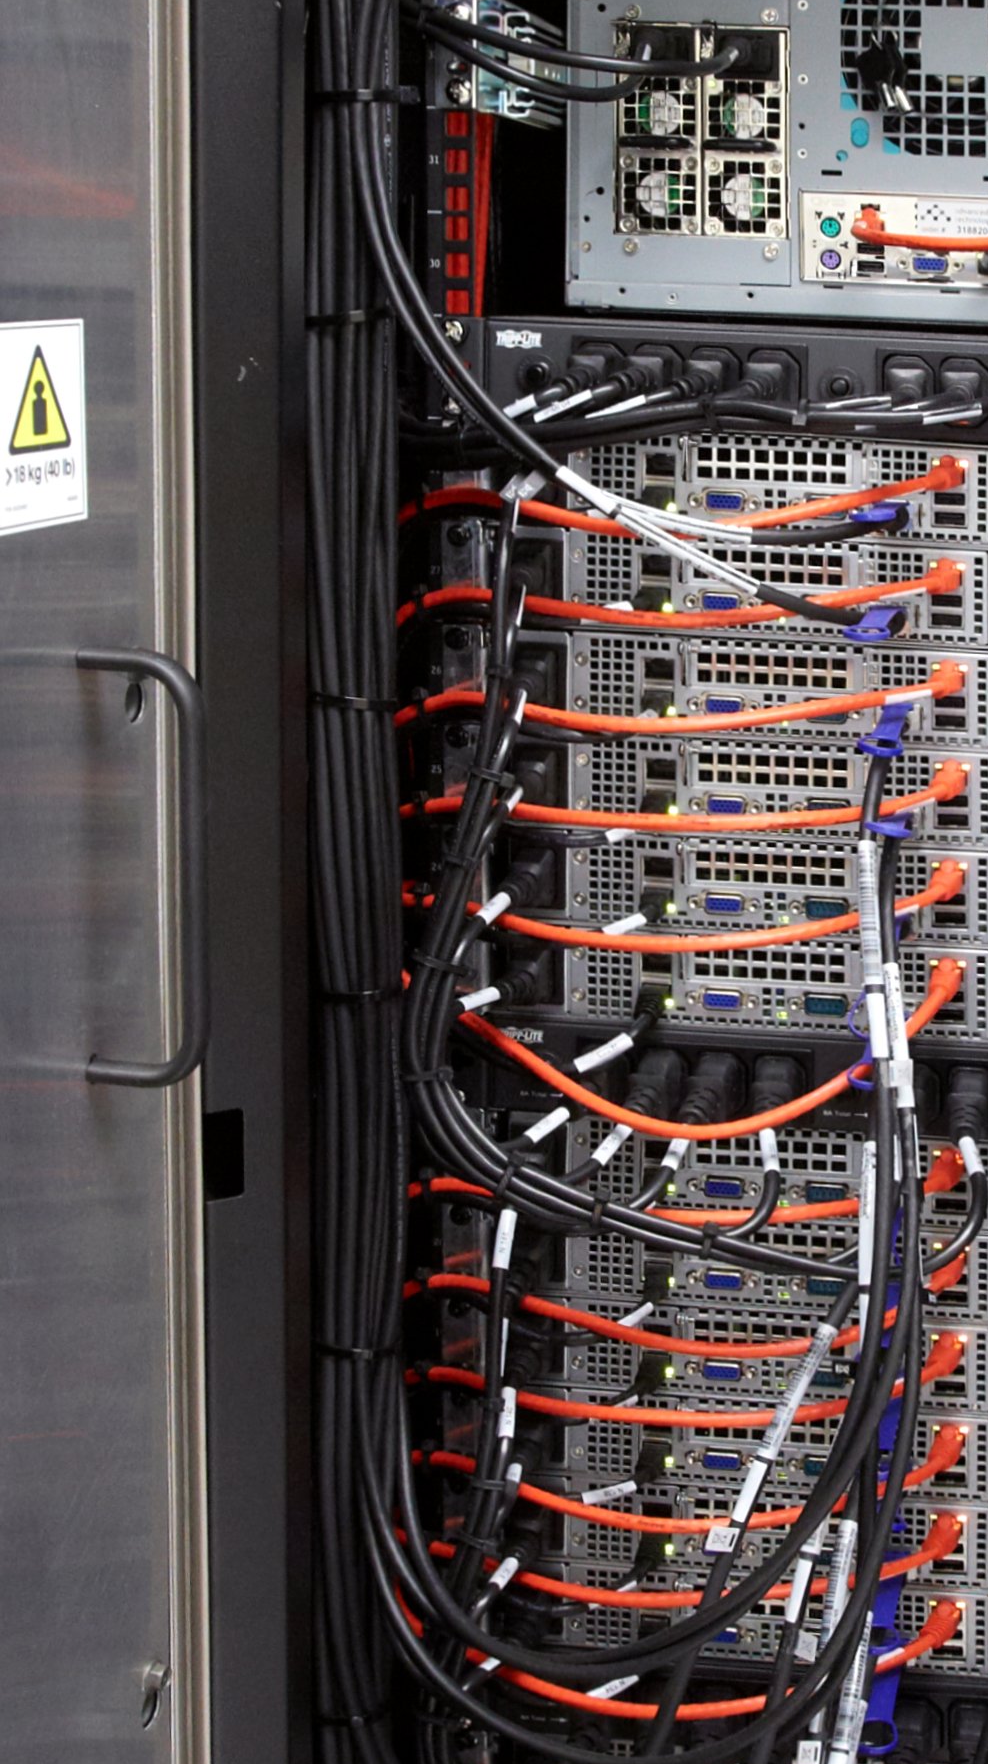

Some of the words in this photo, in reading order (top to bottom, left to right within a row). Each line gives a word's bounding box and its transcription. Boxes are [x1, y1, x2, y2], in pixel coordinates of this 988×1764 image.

[28, 464, 42, 485] kg
[44, 461, 59, 483] (40
[62, 458, 76, 478] lb)
[501, 1026, 544, 1044] RIPP-LITE
